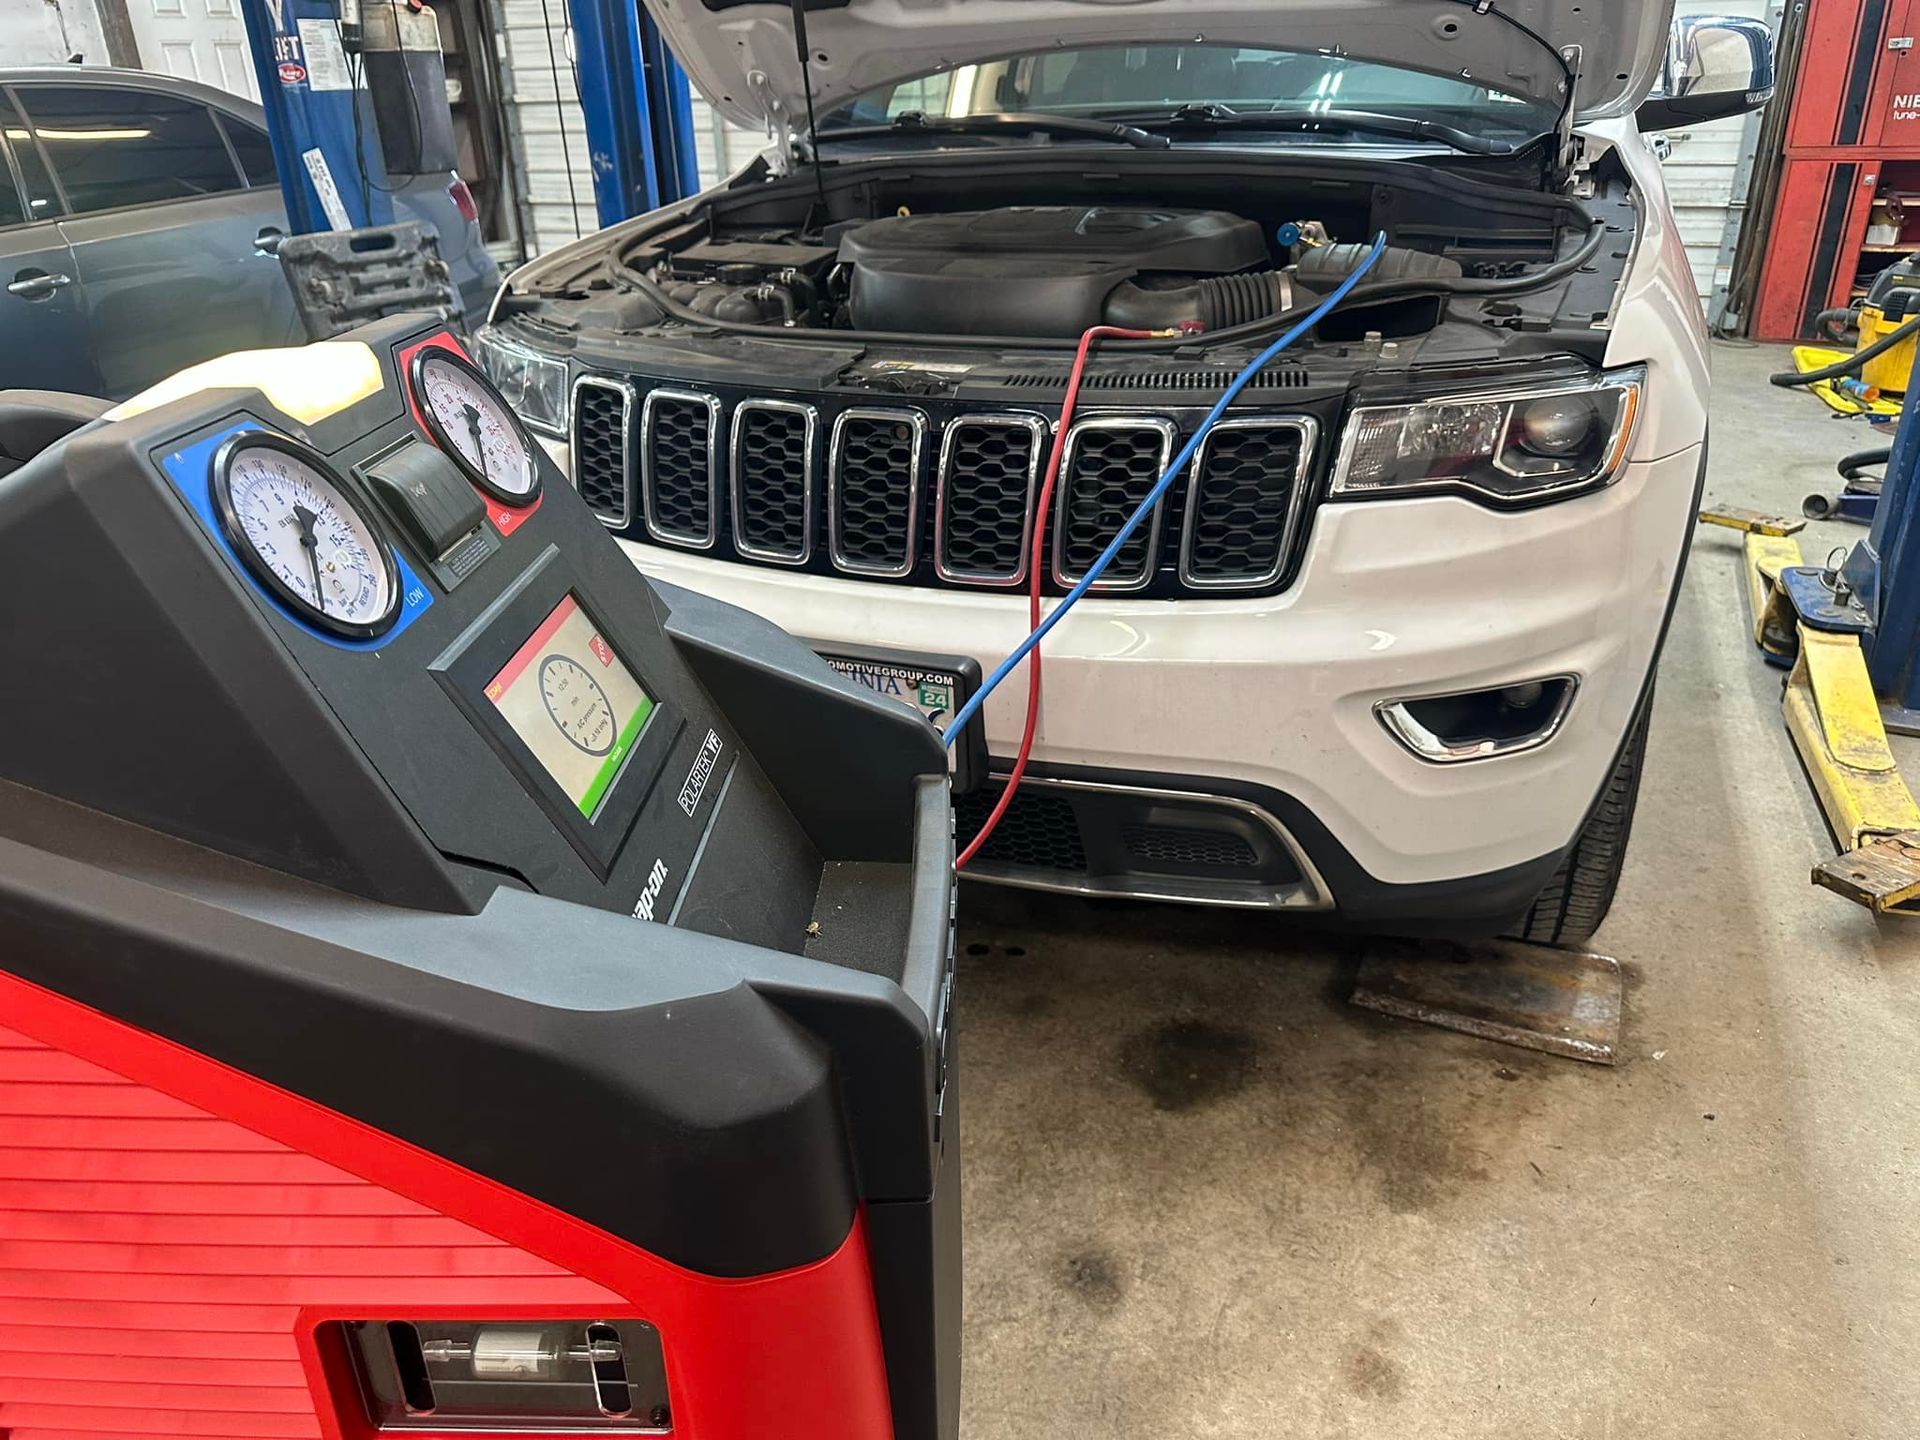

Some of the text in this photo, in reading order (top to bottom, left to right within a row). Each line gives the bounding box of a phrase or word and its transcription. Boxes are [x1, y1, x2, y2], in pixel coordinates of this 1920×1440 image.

[406, 587, 425, 606] LOW
[924, 692, 947, 707] 24
[680, 732, 722, 813] POLARTEK YF
[632, 858, 669, 921] ap-on
